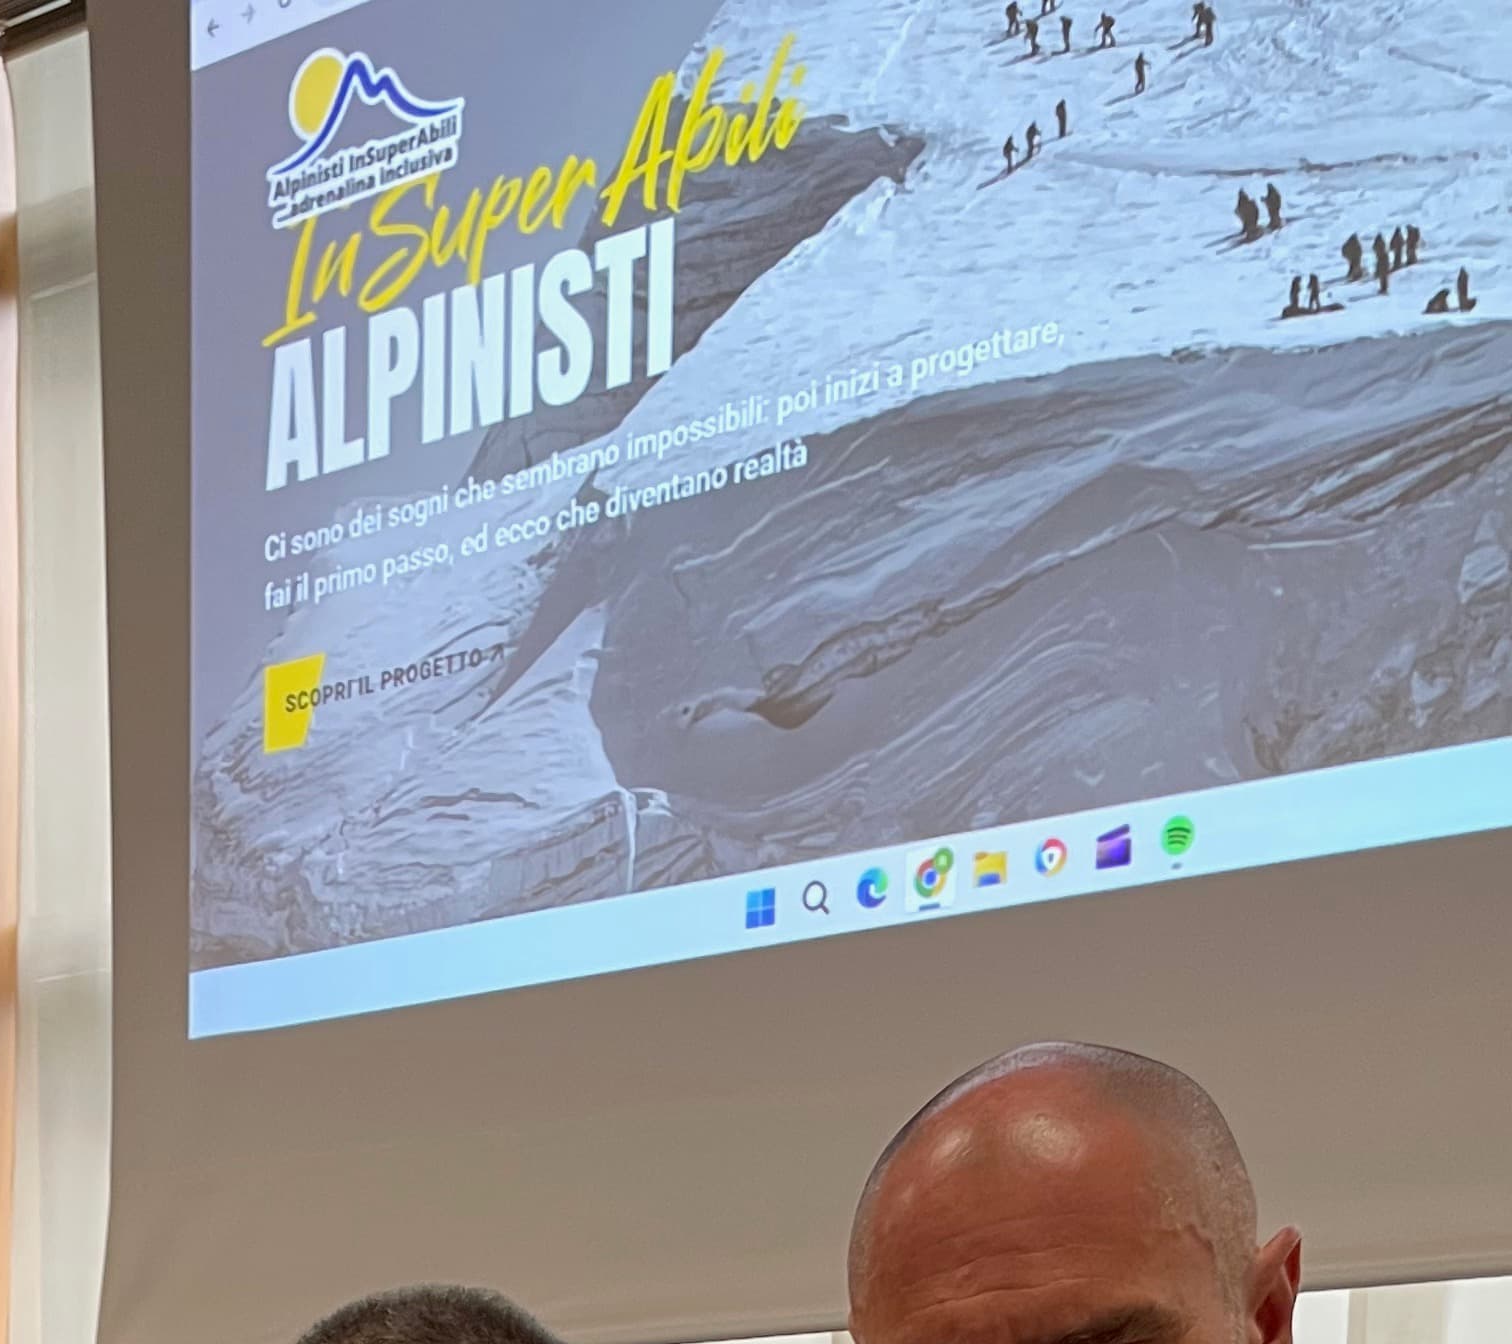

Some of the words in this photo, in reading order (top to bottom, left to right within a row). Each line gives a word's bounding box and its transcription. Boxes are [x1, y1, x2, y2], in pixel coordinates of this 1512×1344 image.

[273, 156, 344, 201] Alpinisti
[349, 116, 457, 173] InSuperAbili
[380, 146, 452, 186] inclusiva
[265, 217, 676, 491] ALPINISTI
[264, 532, 286, 562] Ci
[290, 523, 344, 555] sono
[349, 504, 382, 538] dei
[388, 485, 449, 527] sogni
[455, 476, 496, 508] che
[501, 444, 619, 495] sembrano
[627, 395, 769, 460] impossibili:
[776, 379, 817, 426] poi
[825, 362, 879, 404] inizi
[887, 364, 903, 387] a
[911, 320, 1065, 390] progettare,
[264, 577, 291, 611] fai
[296, 572, 309, 603] il
[315, 561, 376, 604] primo
[383, 543, 454, 586] passo,
[460, 523, 488, 556] ed
[495, 515, 550, 548] ecco
[556, 496, 600, 531] che
[605, 466, 728, 518] diventano
[733, 438, 808, 484] realtà
[285, 680, 353, 713] SCOPRI
[381, 648, 482, 690] PROGETTO
